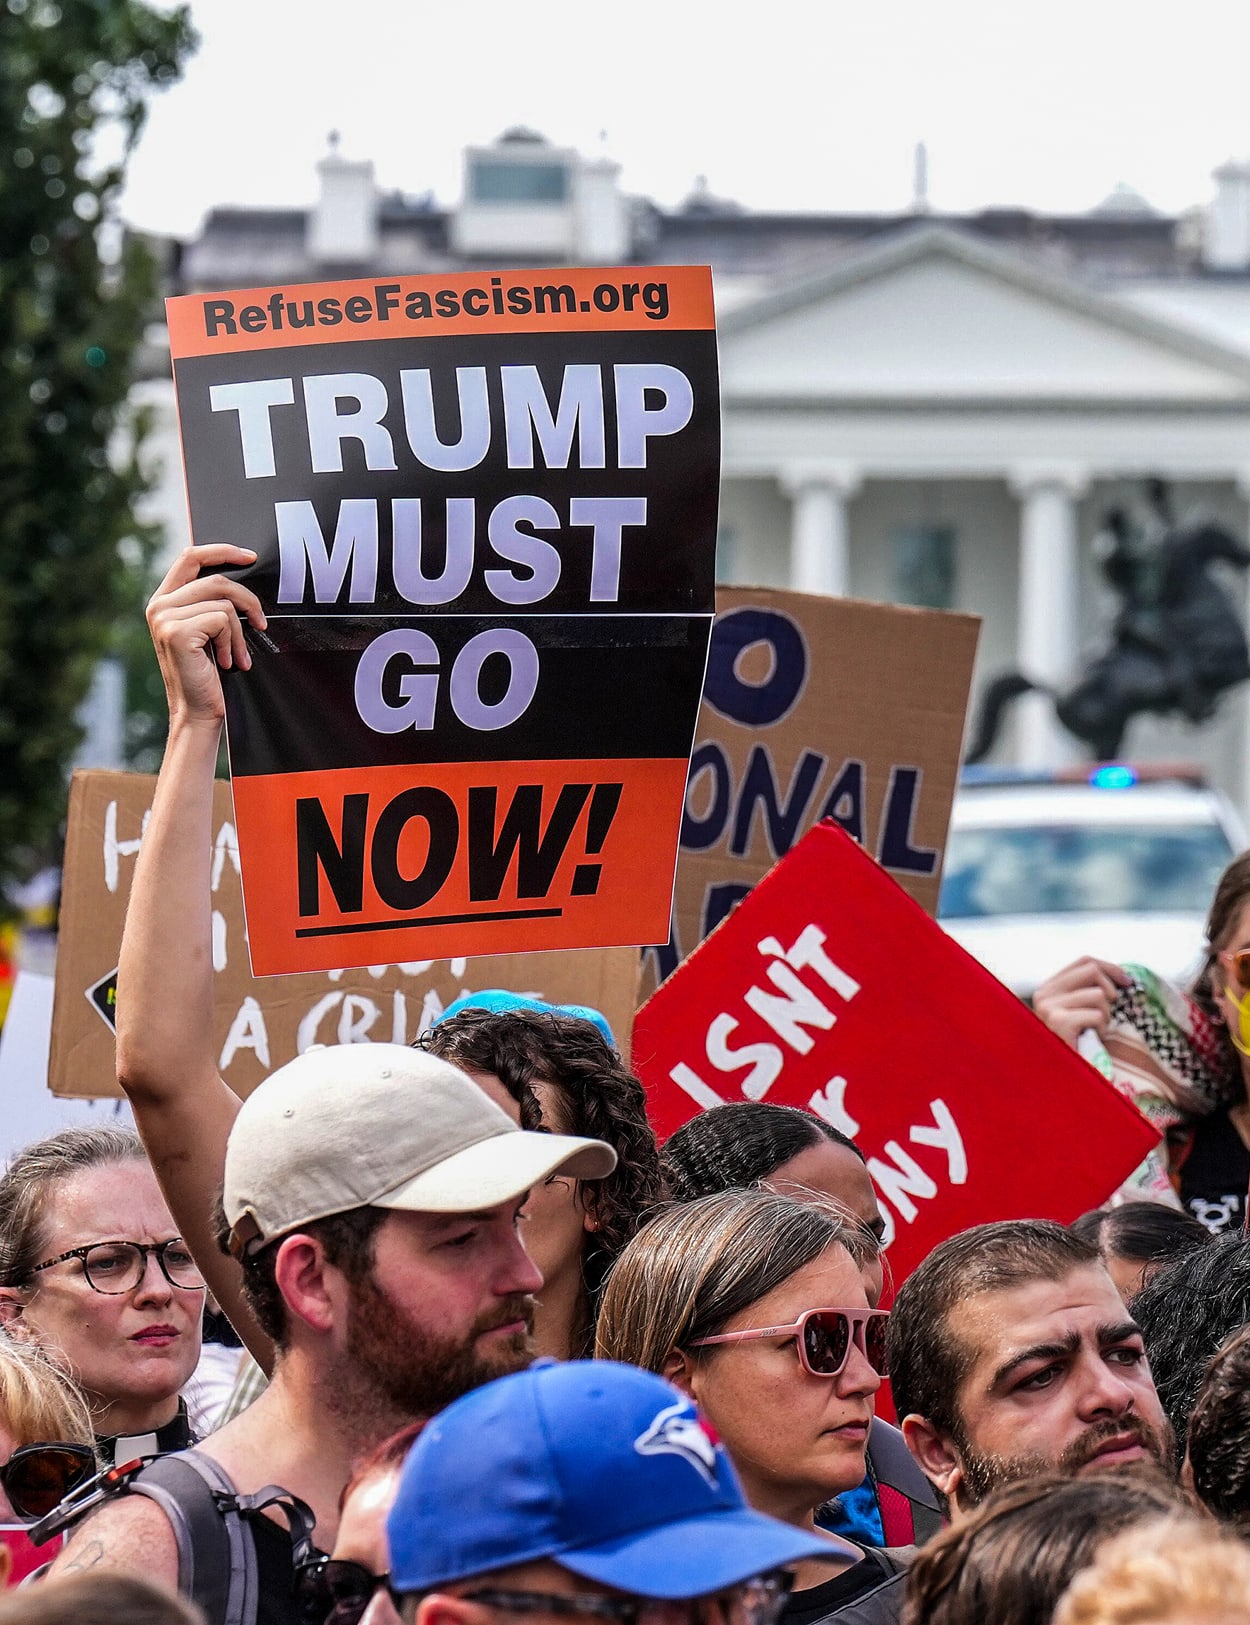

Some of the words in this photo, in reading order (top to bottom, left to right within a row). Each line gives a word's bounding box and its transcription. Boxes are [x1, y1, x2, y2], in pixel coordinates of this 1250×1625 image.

[204, 277, 670, 336] RefuseFascism.org
[209, 363, 695, 480] TRUMP
[273, 494, 648, 606] MUST
[354, 628, 540, 734] GO
[296, 783, 624, 918] NOW!
[668, 923, 862, 1112] ISN'T
